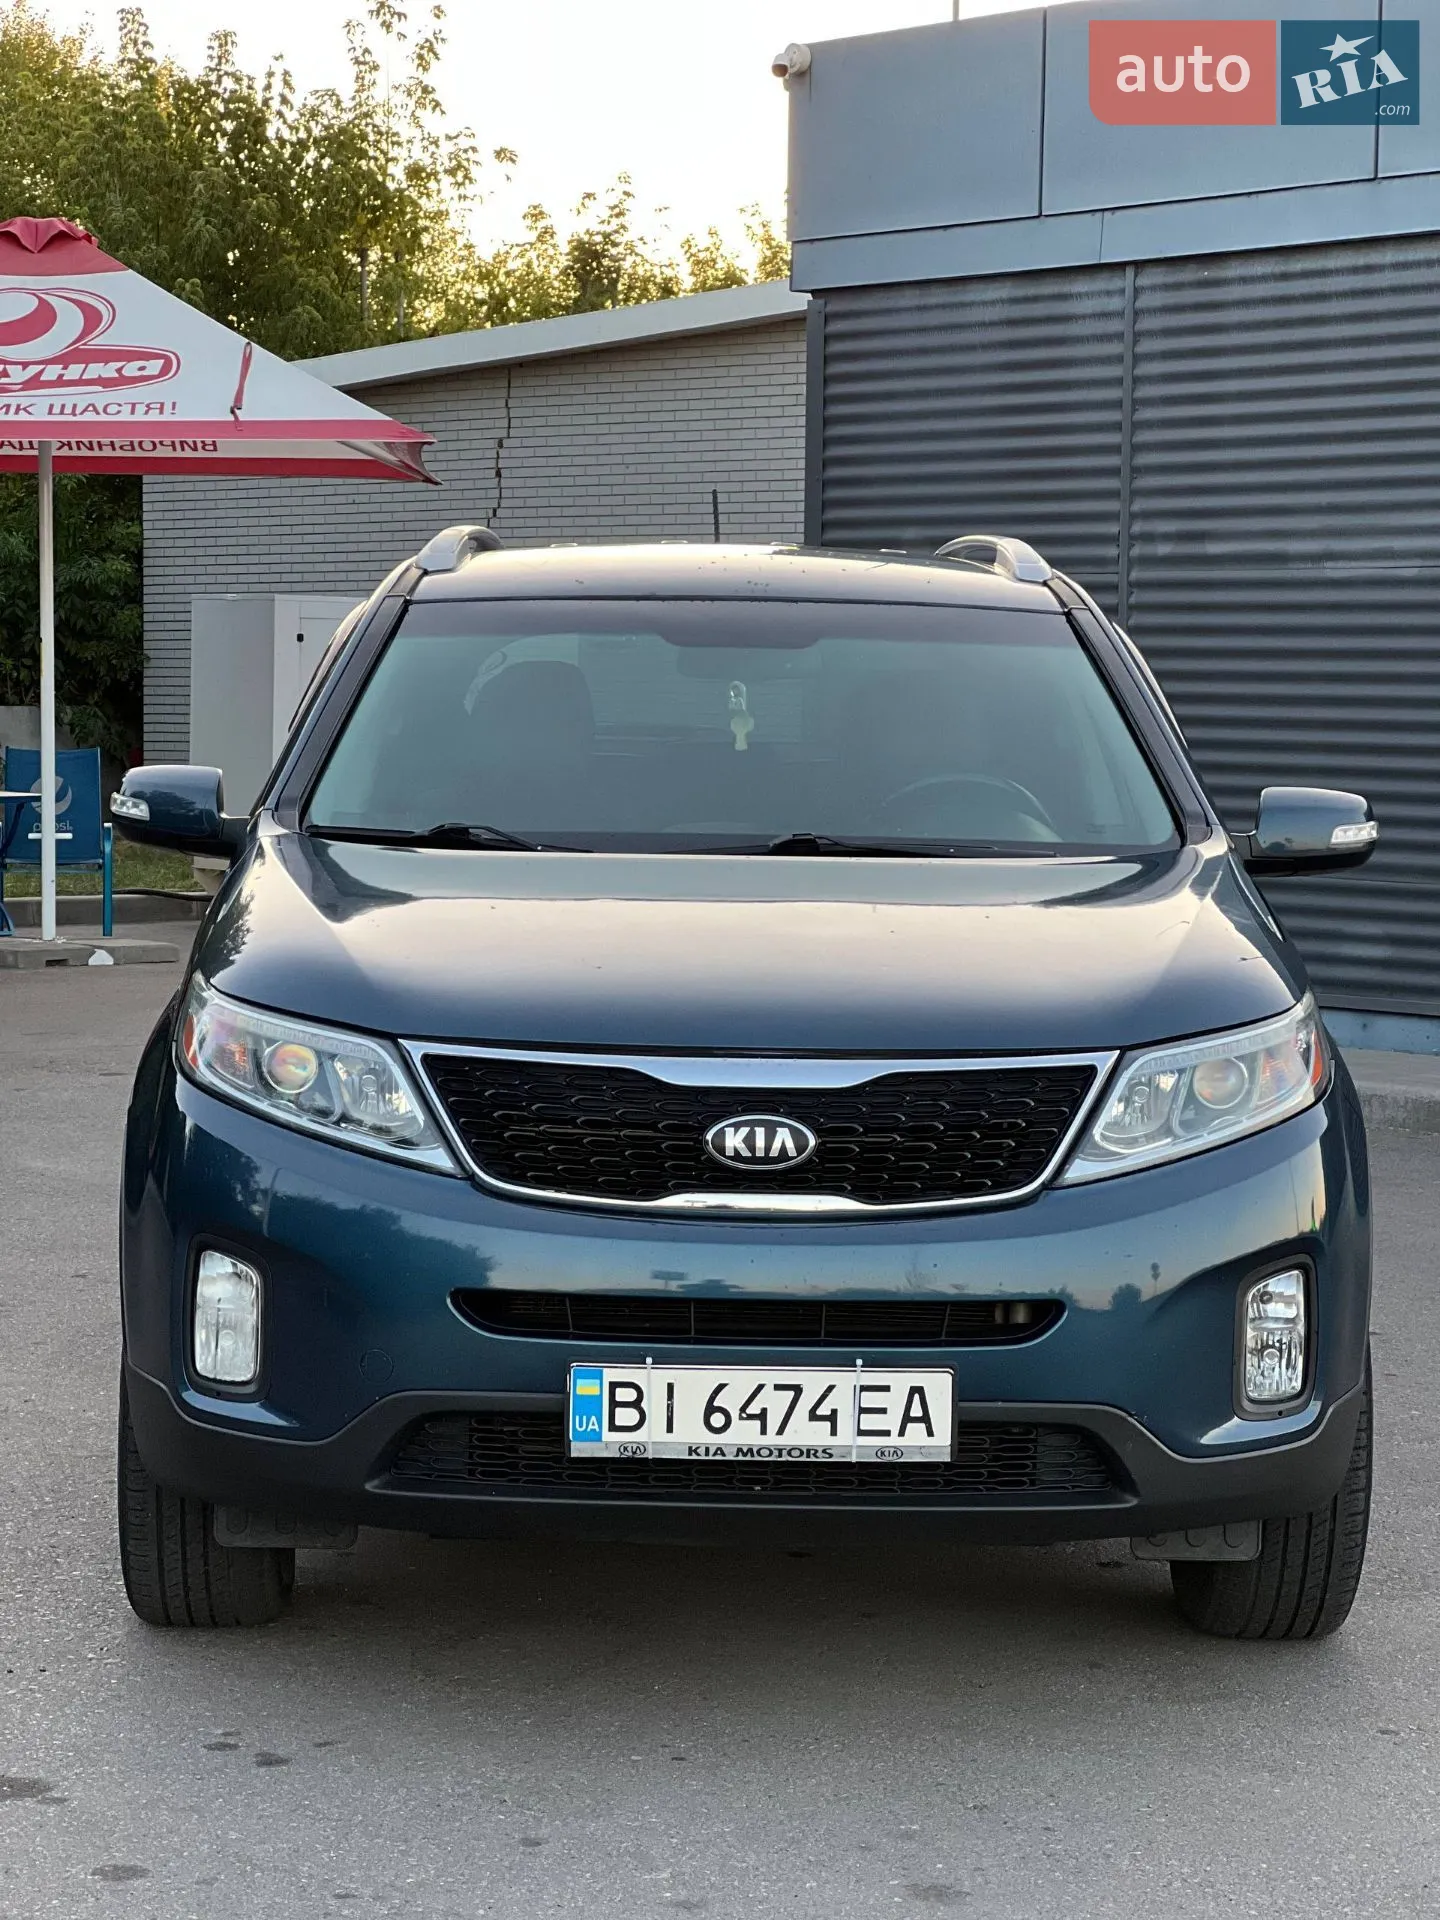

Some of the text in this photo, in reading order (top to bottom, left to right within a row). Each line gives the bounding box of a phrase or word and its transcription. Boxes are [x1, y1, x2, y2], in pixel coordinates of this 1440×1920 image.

[0, 359, 165, 383] унка
[47, 401, 177, 417] ЩАСТЯ!
[724, 1127, 797, 1156] KIA
[608, 1381, 934, 1437] BI 6474 EA
[575, 1415, 599, 1431] UA
[688, 1446, 834, 1459] KIA MOTORS
[880, 1450, 899, 1458] KIA
